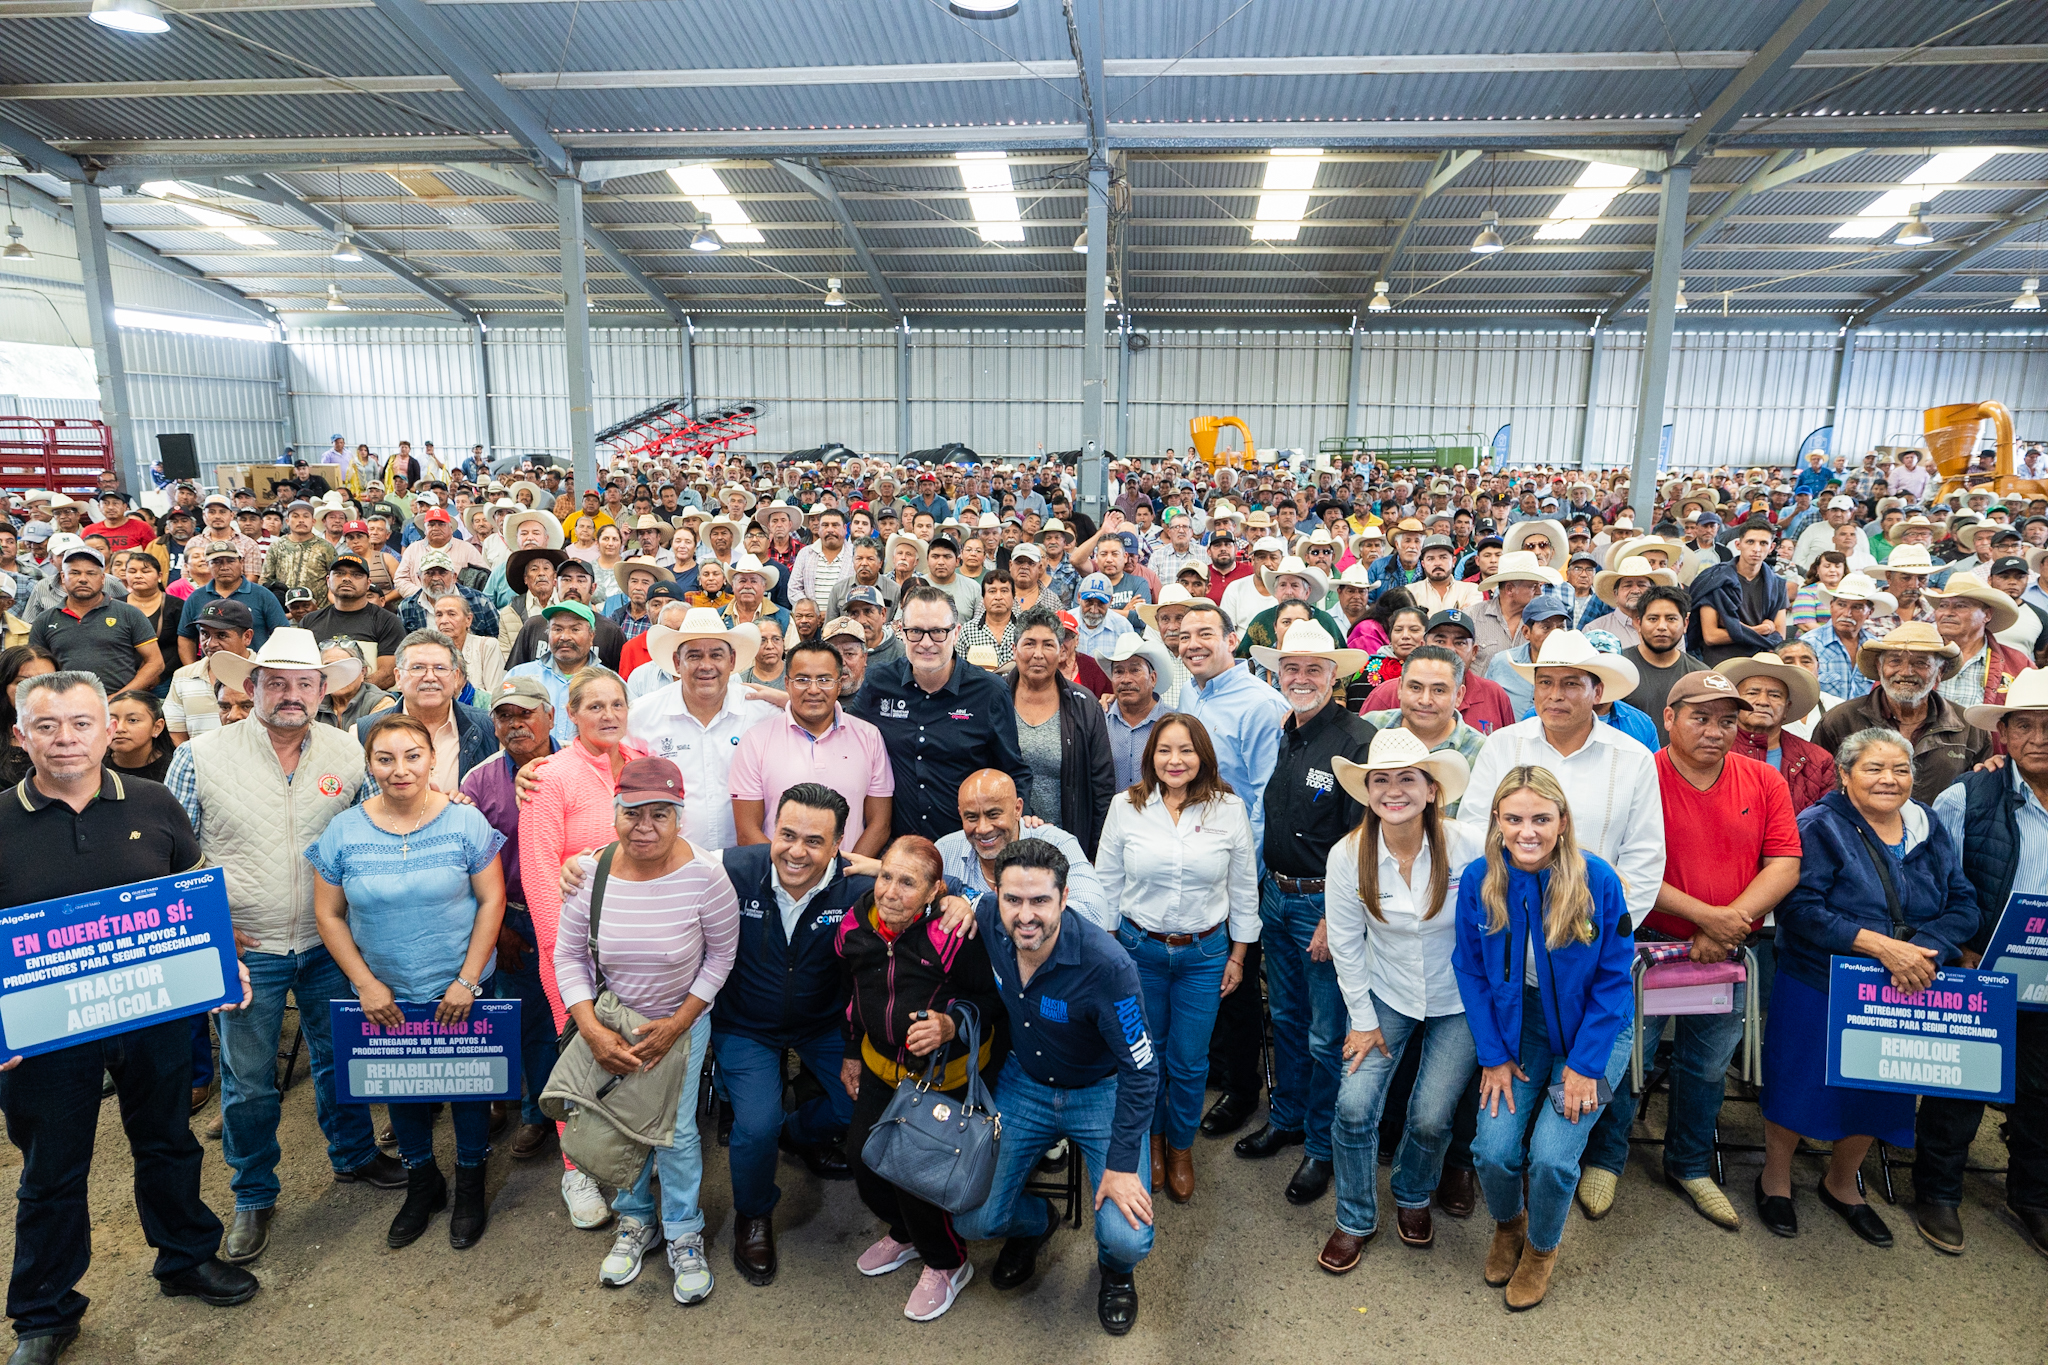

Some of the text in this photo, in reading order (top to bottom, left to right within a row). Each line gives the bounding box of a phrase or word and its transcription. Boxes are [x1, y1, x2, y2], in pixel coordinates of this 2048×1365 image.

[1090, 579, 1104, 591] LA
[1306, 772, 1334, 786] SOMOS
[1306, 779, 1333, 792] TODOS
[174, 874, 214, 889] CONTIGO
[12, 898, 193, 958] EN QUERÉTARO SÍ:
[816, 914, 846, 926] CONTI
[2024, 917, 2046, 933] EN
[25, 924, 187, 970] ENTREGAMOS 100 MIL APOYOS A
[3, 932, 211, 989] PRODUCTORES PARA SEGUIR COSECHANDO
[1840, 963, 1884, 973] #PorAlgoSerá
[64, 963, 165, 1005] TRACTOR
[1978, 975, 2009, 984] CONTIGO
[1858, 983, 1877, 1002] EN
[1968, 991, 1988, 1013] SÍ:
[67, 987, 172, 1032] AGRÍCOLA
[482, 1003, 513, 1012] CONTIGO
[1864, 1004, 1980, 1025] ENTREGAMOS 100 MIL APOYOS A
[361, 1018, 493, 1036] EN QUERÉTARO SÍ:
[1113, 995, 1154, 1070] AGUSTÍN
[1847, 1014, 1997, 1039] PRODUCTORES PARA SEGUIR COSECHANDO
[352, 1045, 503, 1056] PRODUCTORES PARA SEGUIR COSECHANDO
[369, 1037, 486, 1046] ENTREGAMOS 100 MIL APOYOS A
[1881, 1037, 1961, 1063] REMOLQUE
[366, 1059, 490, 1079] REHABILITACIÓN
[1878, 1059, 1962, 1086] GANADERO
[364, 1078, 494, 1095] DE INVERNADERO
